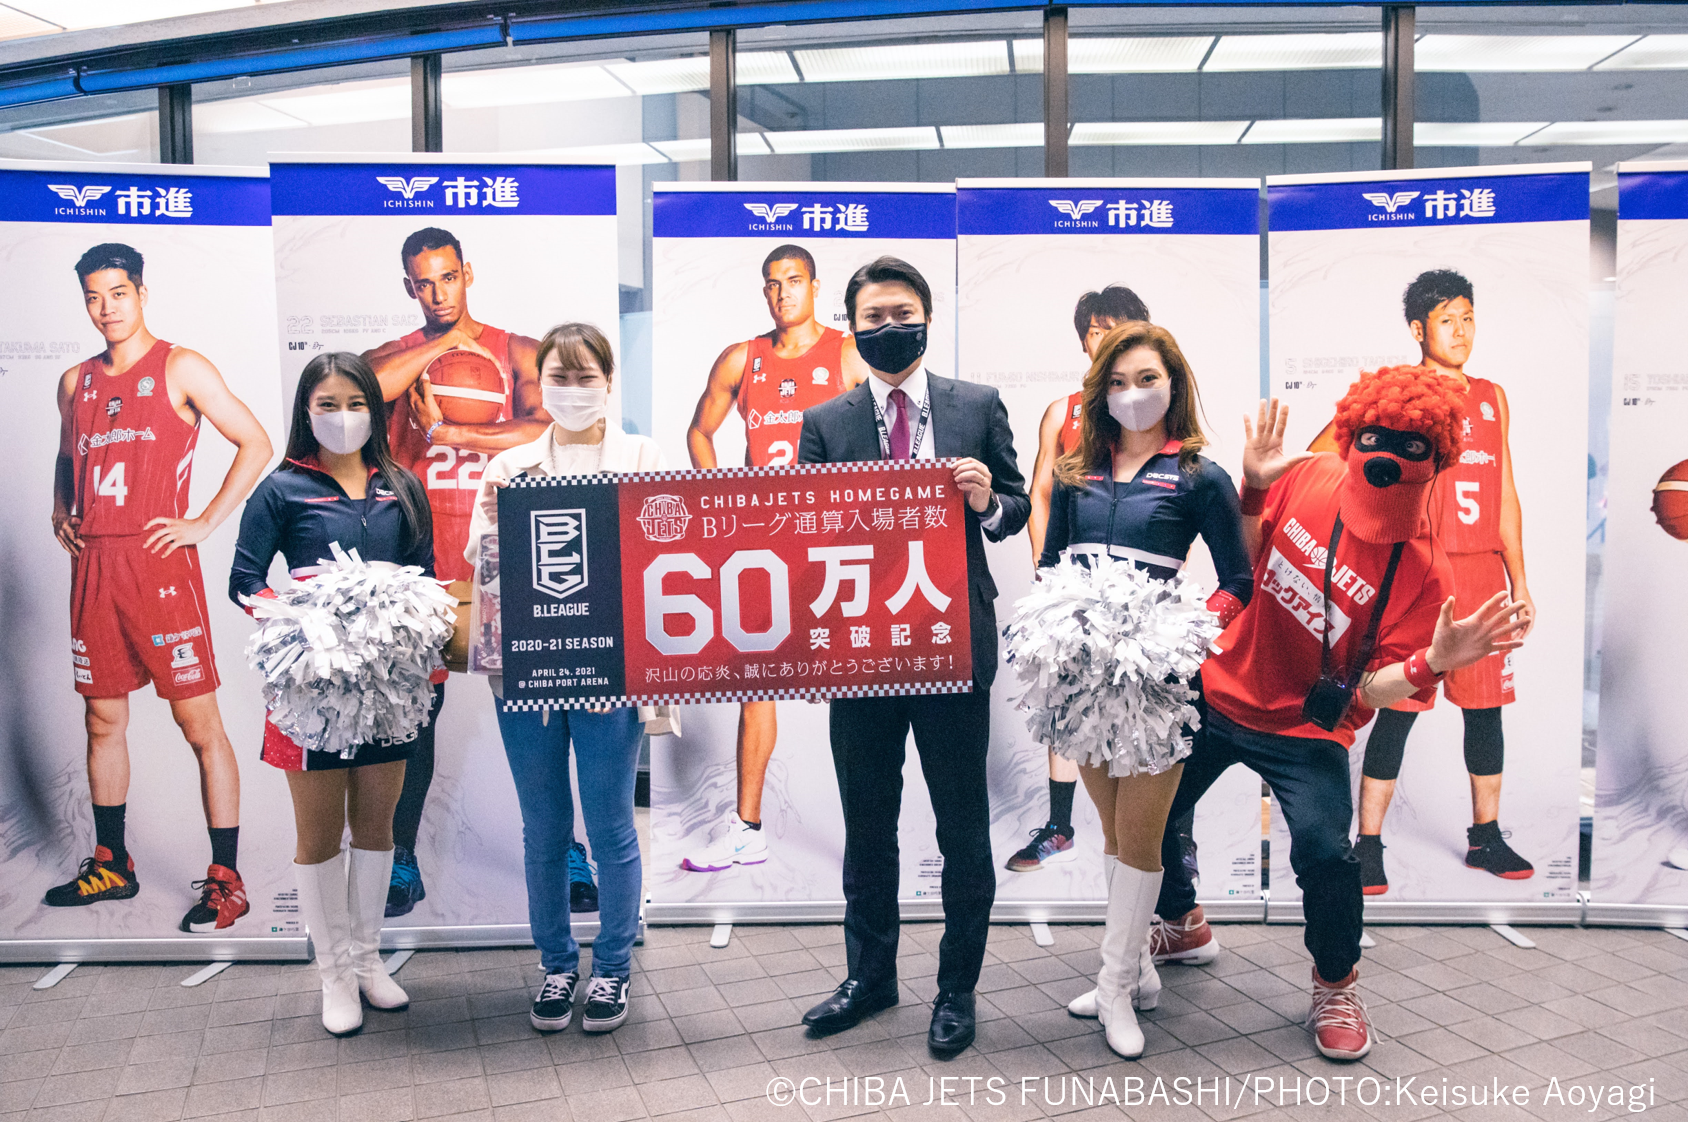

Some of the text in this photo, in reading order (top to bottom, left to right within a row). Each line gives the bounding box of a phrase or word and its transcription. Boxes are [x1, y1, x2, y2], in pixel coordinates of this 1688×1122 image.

[114, 186, 193, 217] 市進
[384, 200, 434, 208] ICHISHIN
[442, 176, 520, 208] 市進
[1422, 188, 1496, 219] 市進
[55, 207, 106, 216] ICHISHIN
[801, 203, 869, 231] 市進
[1106, 199, 1174, 228] 市進
[1368, 213, 1415, 221] ICHISHIN
[749, 223, 793, 231] ICHISHIN
[1054, 220, 1099, 228] ICHISHIN
[286, 315, 314, 335] 22
[49, 341, 81, 354] SATO
[763, 410, 804, 425] 金太郎
[767, 439, 801, 467] 2
[426, 445, 488, 490] 22
[93, 462, 128, 506] 14
[700, 485, 945, 509] CHIBAJETS HOMEGAME
[1454, 481, 1480, 525] 5
[702, 505, 948, 539] Bリーグ通算入場者数
[1282, 517, 1376, 606] CHIBA JETS
[533, 602, 590, 617] B.LEAGUE
[511, 636, 614, 652] 2020-21 SEASON
[809, 621, 953, 650] 突破記念
[528, 679, 553, 688] CHIBA
[556, 678, 578, 688] PORT
[581, 677, 609, 687] ARENA
[532, 669, 557, 678] APRIL
[575, 667, 596, 676] 2021
